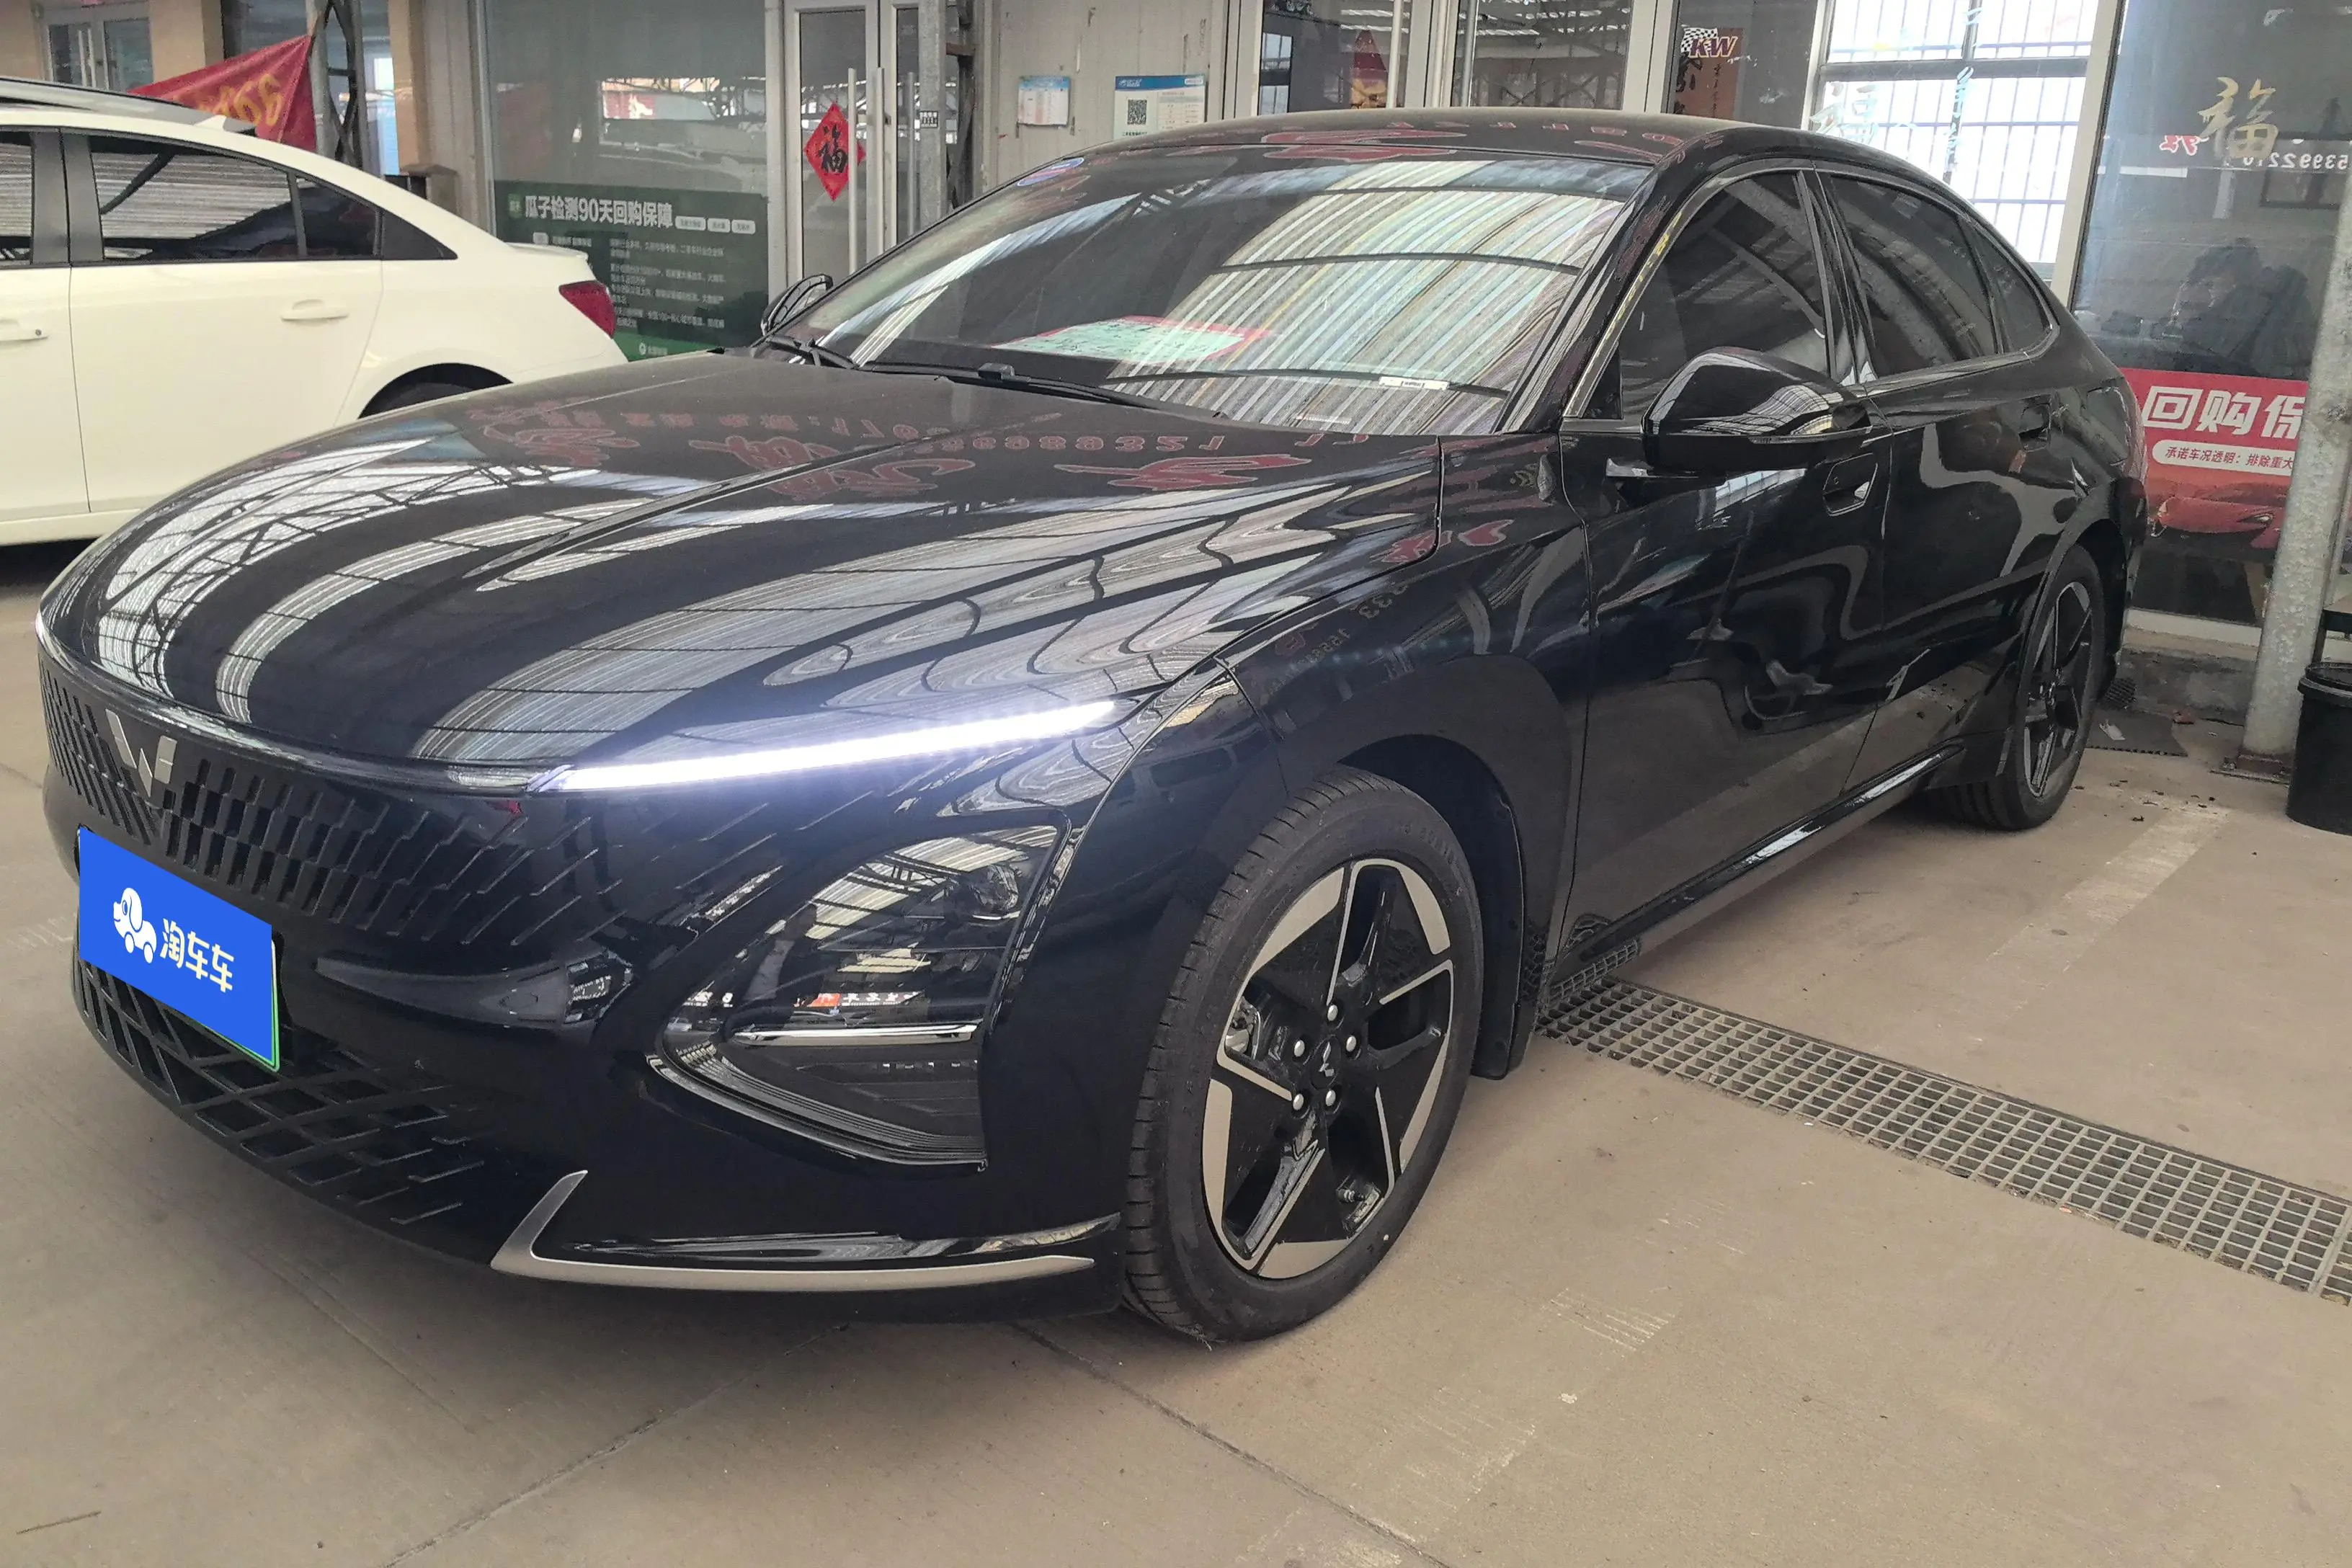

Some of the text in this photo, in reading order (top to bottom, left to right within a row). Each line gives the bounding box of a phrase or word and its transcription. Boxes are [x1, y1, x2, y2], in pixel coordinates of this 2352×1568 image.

[1688, 36, 1739, 58] KW
[818, 124, 848, 174] 福
[525, 195, 673, 229] 瓜子检测90天回购保障
